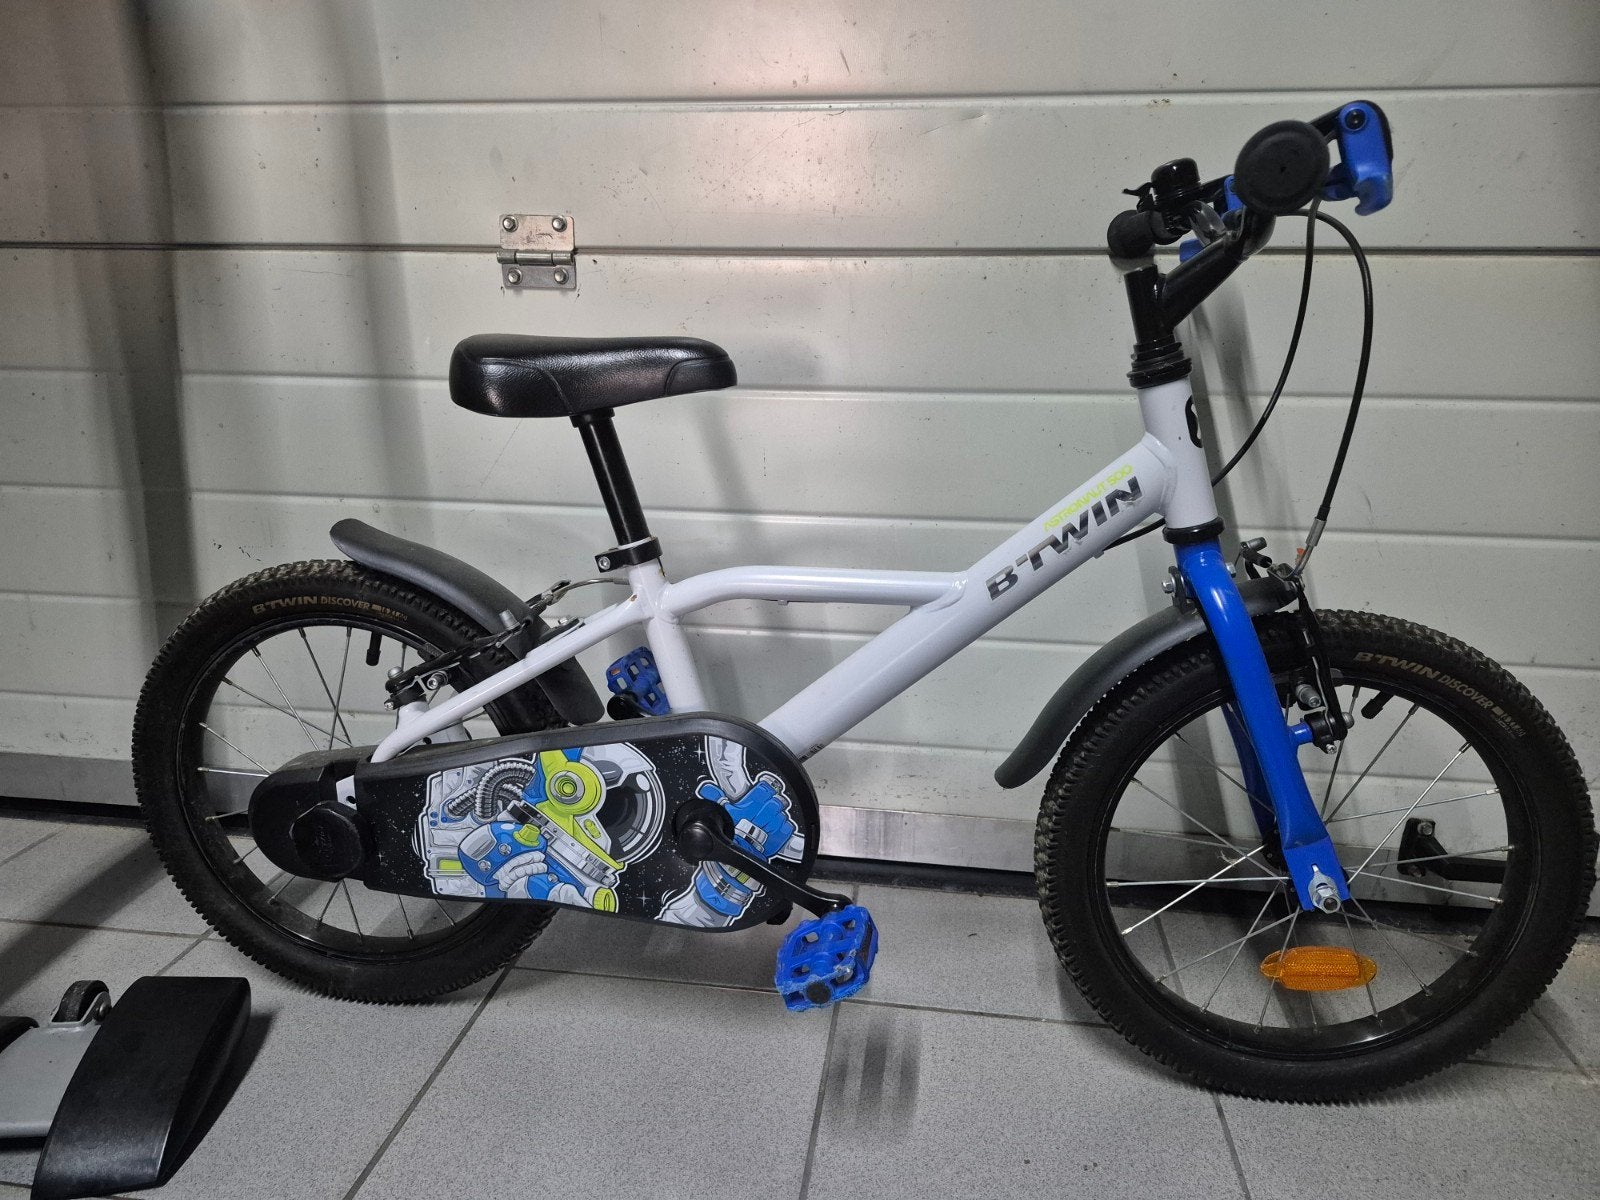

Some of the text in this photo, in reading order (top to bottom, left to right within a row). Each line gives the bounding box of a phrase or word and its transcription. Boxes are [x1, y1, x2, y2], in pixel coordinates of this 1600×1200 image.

[1107, 464, 1134, 487] 500
[320, 596, 370, 610] DISCOVER
[1439, 674, 1493, 709] DISCOVER
